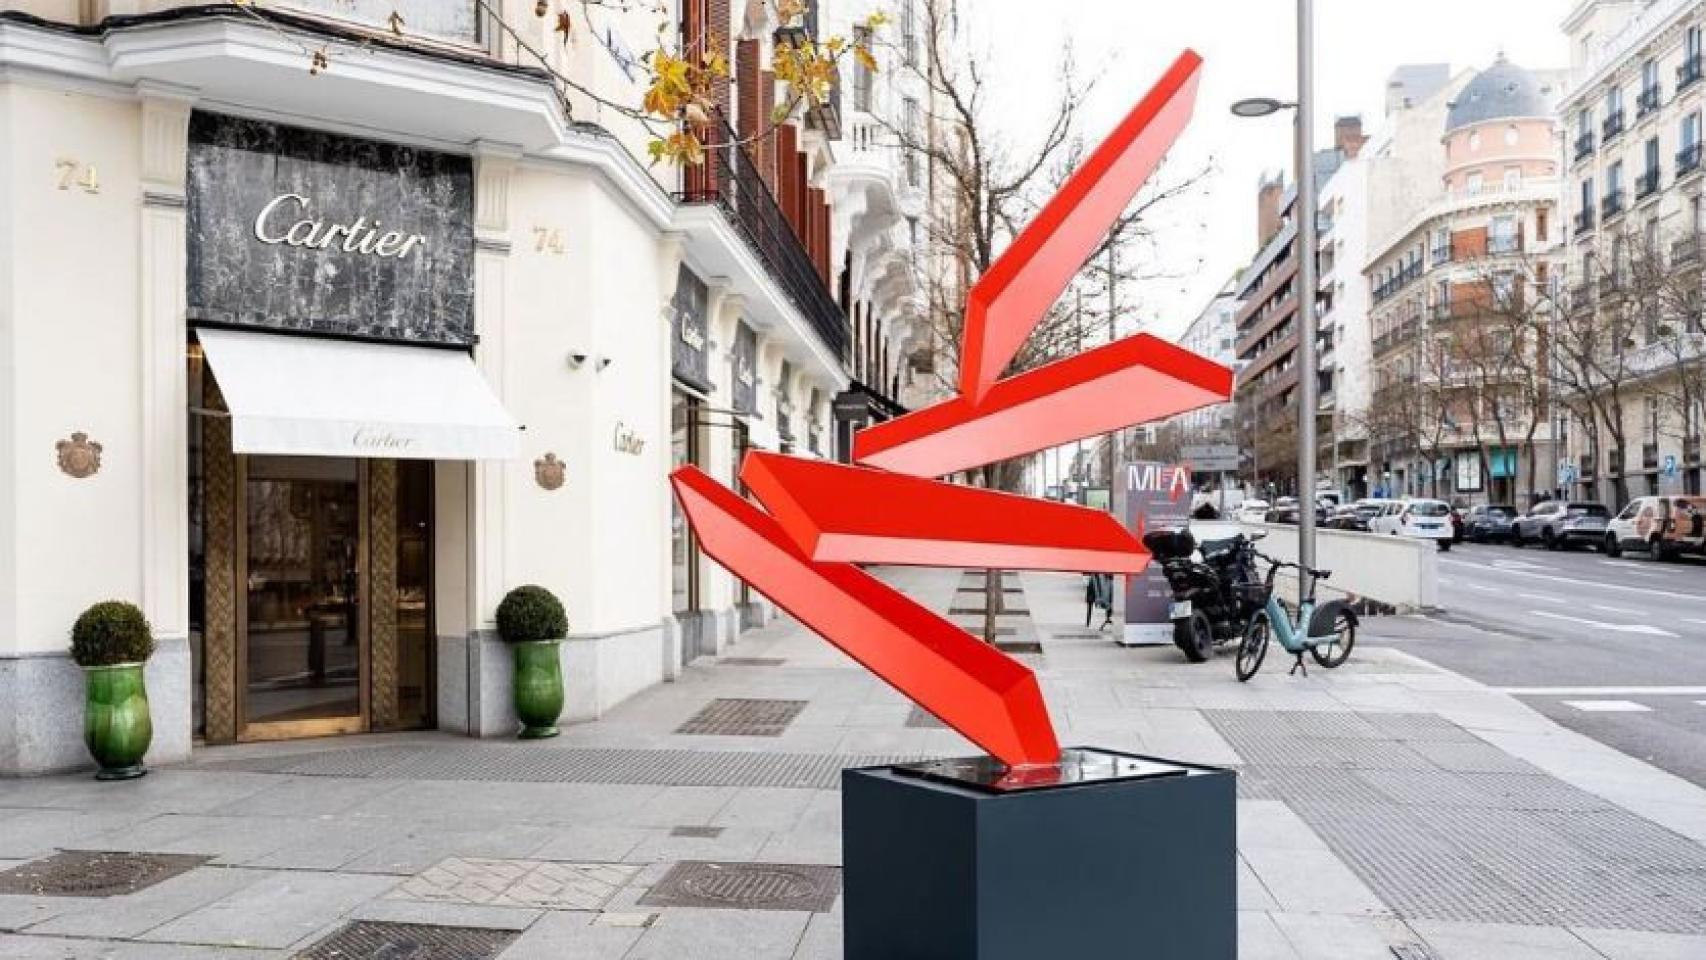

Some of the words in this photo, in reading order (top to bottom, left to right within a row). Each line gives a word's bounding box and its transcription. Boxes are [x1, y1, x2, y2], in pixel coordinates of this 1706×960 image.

[55, 158, 99, 195] 74
[254, 193, 427, 258] Cartier
[532, 225, 566, 255] 74
